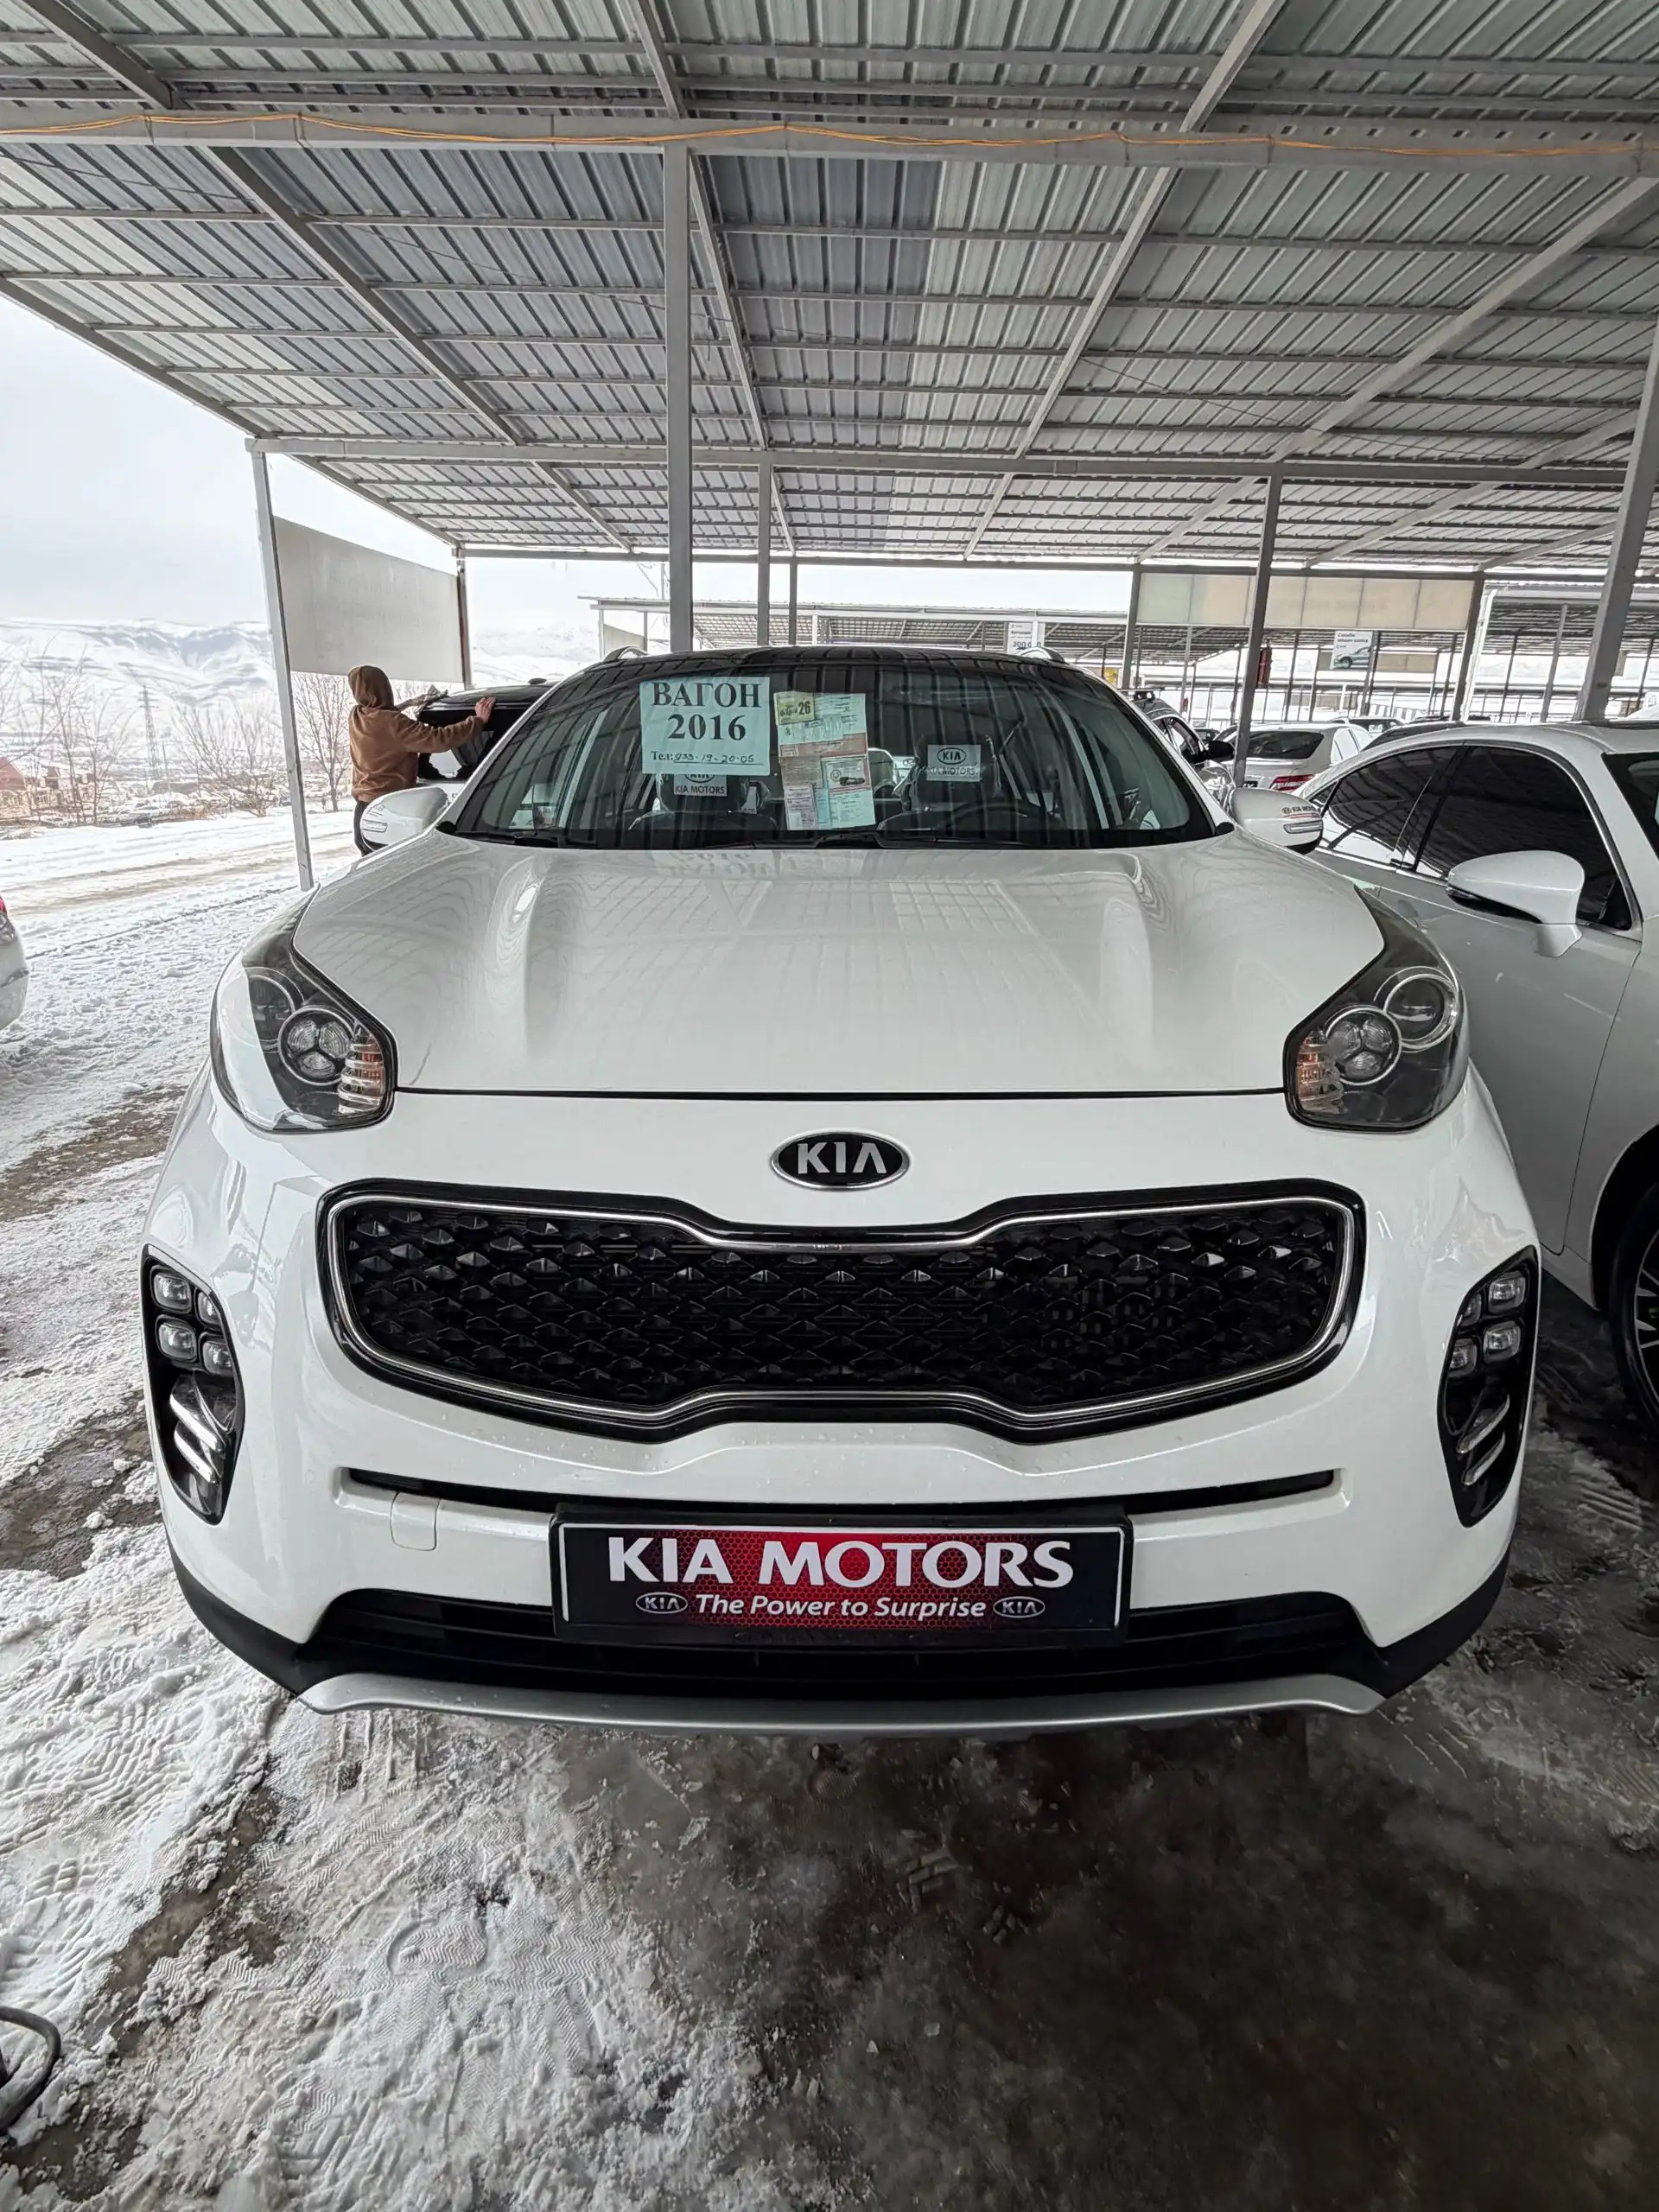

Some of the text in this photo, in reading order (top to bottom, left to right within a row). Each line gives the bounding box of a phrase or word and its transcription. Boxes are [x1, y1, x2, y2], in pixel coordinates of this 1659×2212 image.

[652, 682, 762, 708] ВАГОН
[798, 701, 811, 715] 26
[667, 714, 747, 741] 2016
[943, 752, 961, 760] KIA
[676, 785, 725, 794] KIA MOTORS
[798, 1141, 887, 1174] KIA
[608, 1536, 1074, 1588] KIA MOTORS
[645, 1597, 680, 1611] KIA
[695, 1593, 986, 1621] The Power to Surprise
[1001, 1601, 1037, 1615] KIA
